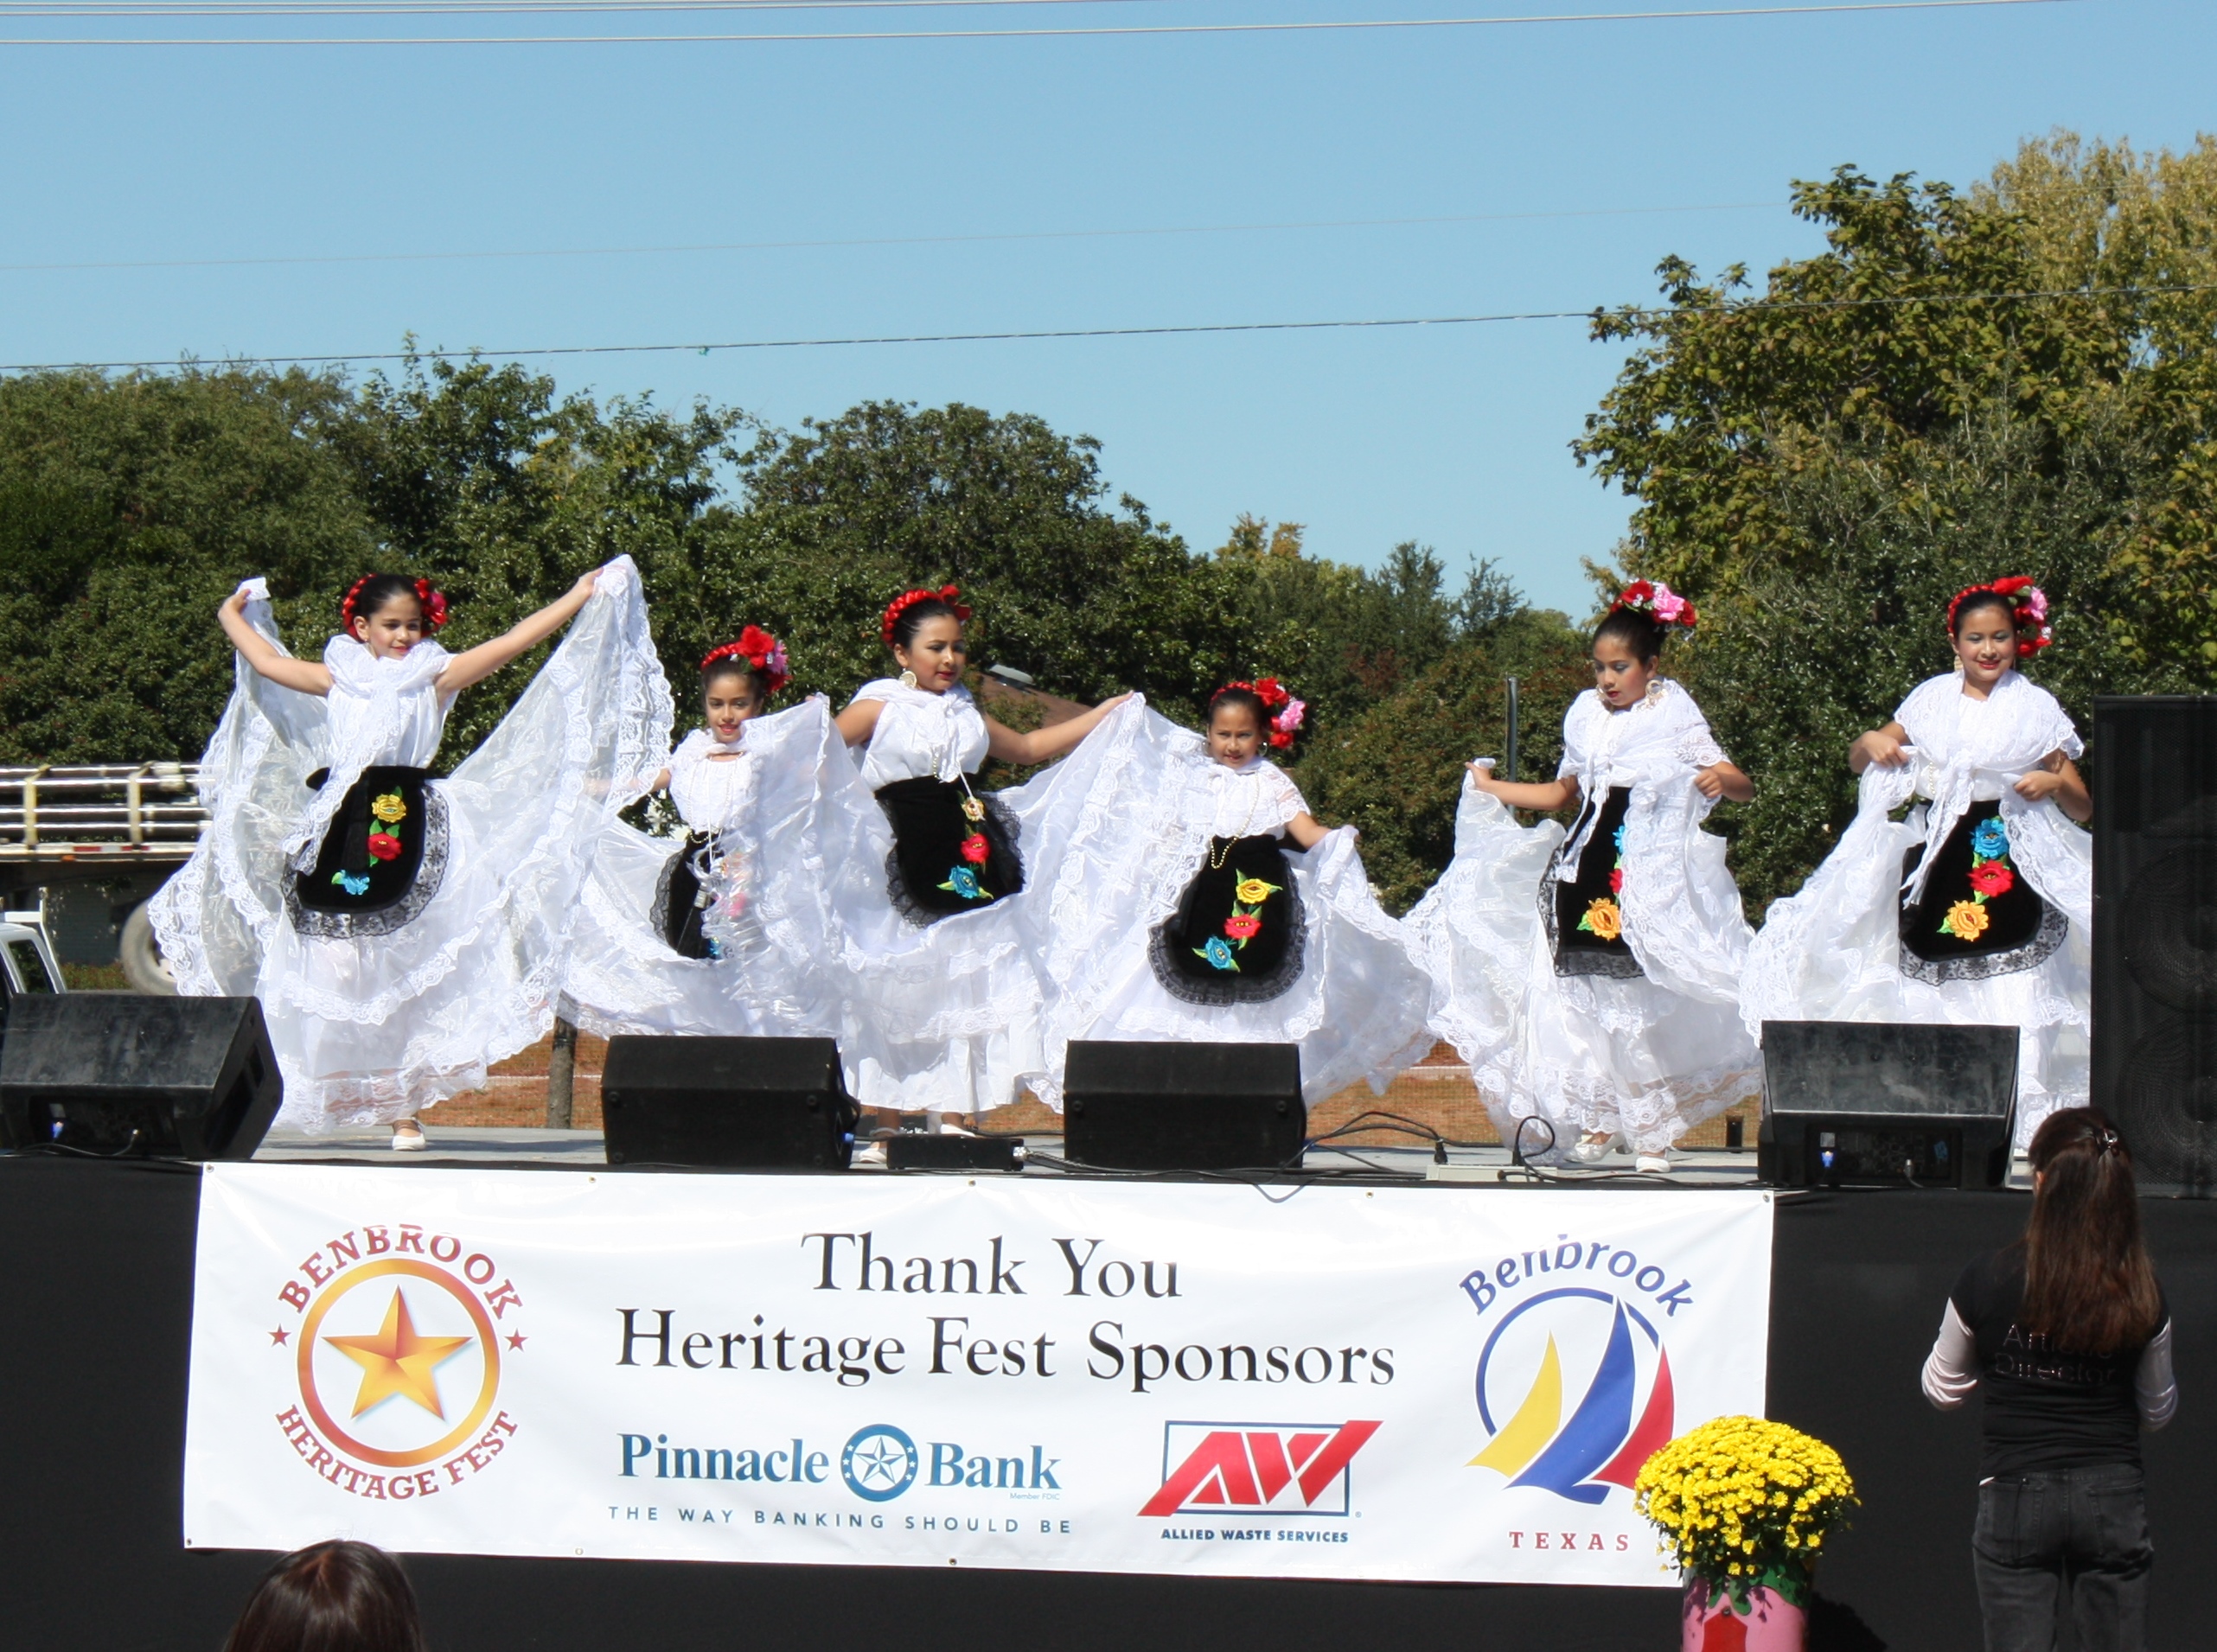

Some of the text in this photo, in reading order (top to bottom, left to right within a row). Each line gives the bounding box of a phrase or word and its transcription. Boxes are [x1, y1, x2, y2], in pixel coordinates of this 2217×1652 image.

[277, 1223, 524, 1320] BENBROOK
[801, 1230, 1183, 1298] Thank You
[1459, 1233, 1694, 1317] Benbrook
[615, 1307, 1396, 1394] Heritage Fest Sponsors
[275, 1405, 519, 1500] HERITAGE FEST
[617, 1432, 1063, 1490] Pinnacle Bank
[608, 1506, 1071, 1534] THE WAY BANKING SHOULD BE
[1041, 1492, 1061, 1501] FDIC
[1160, 1528, 1349, 1543] ALLIED WASTE SERVICES
[1508, 1531, 1630, 1552] TEXAS
